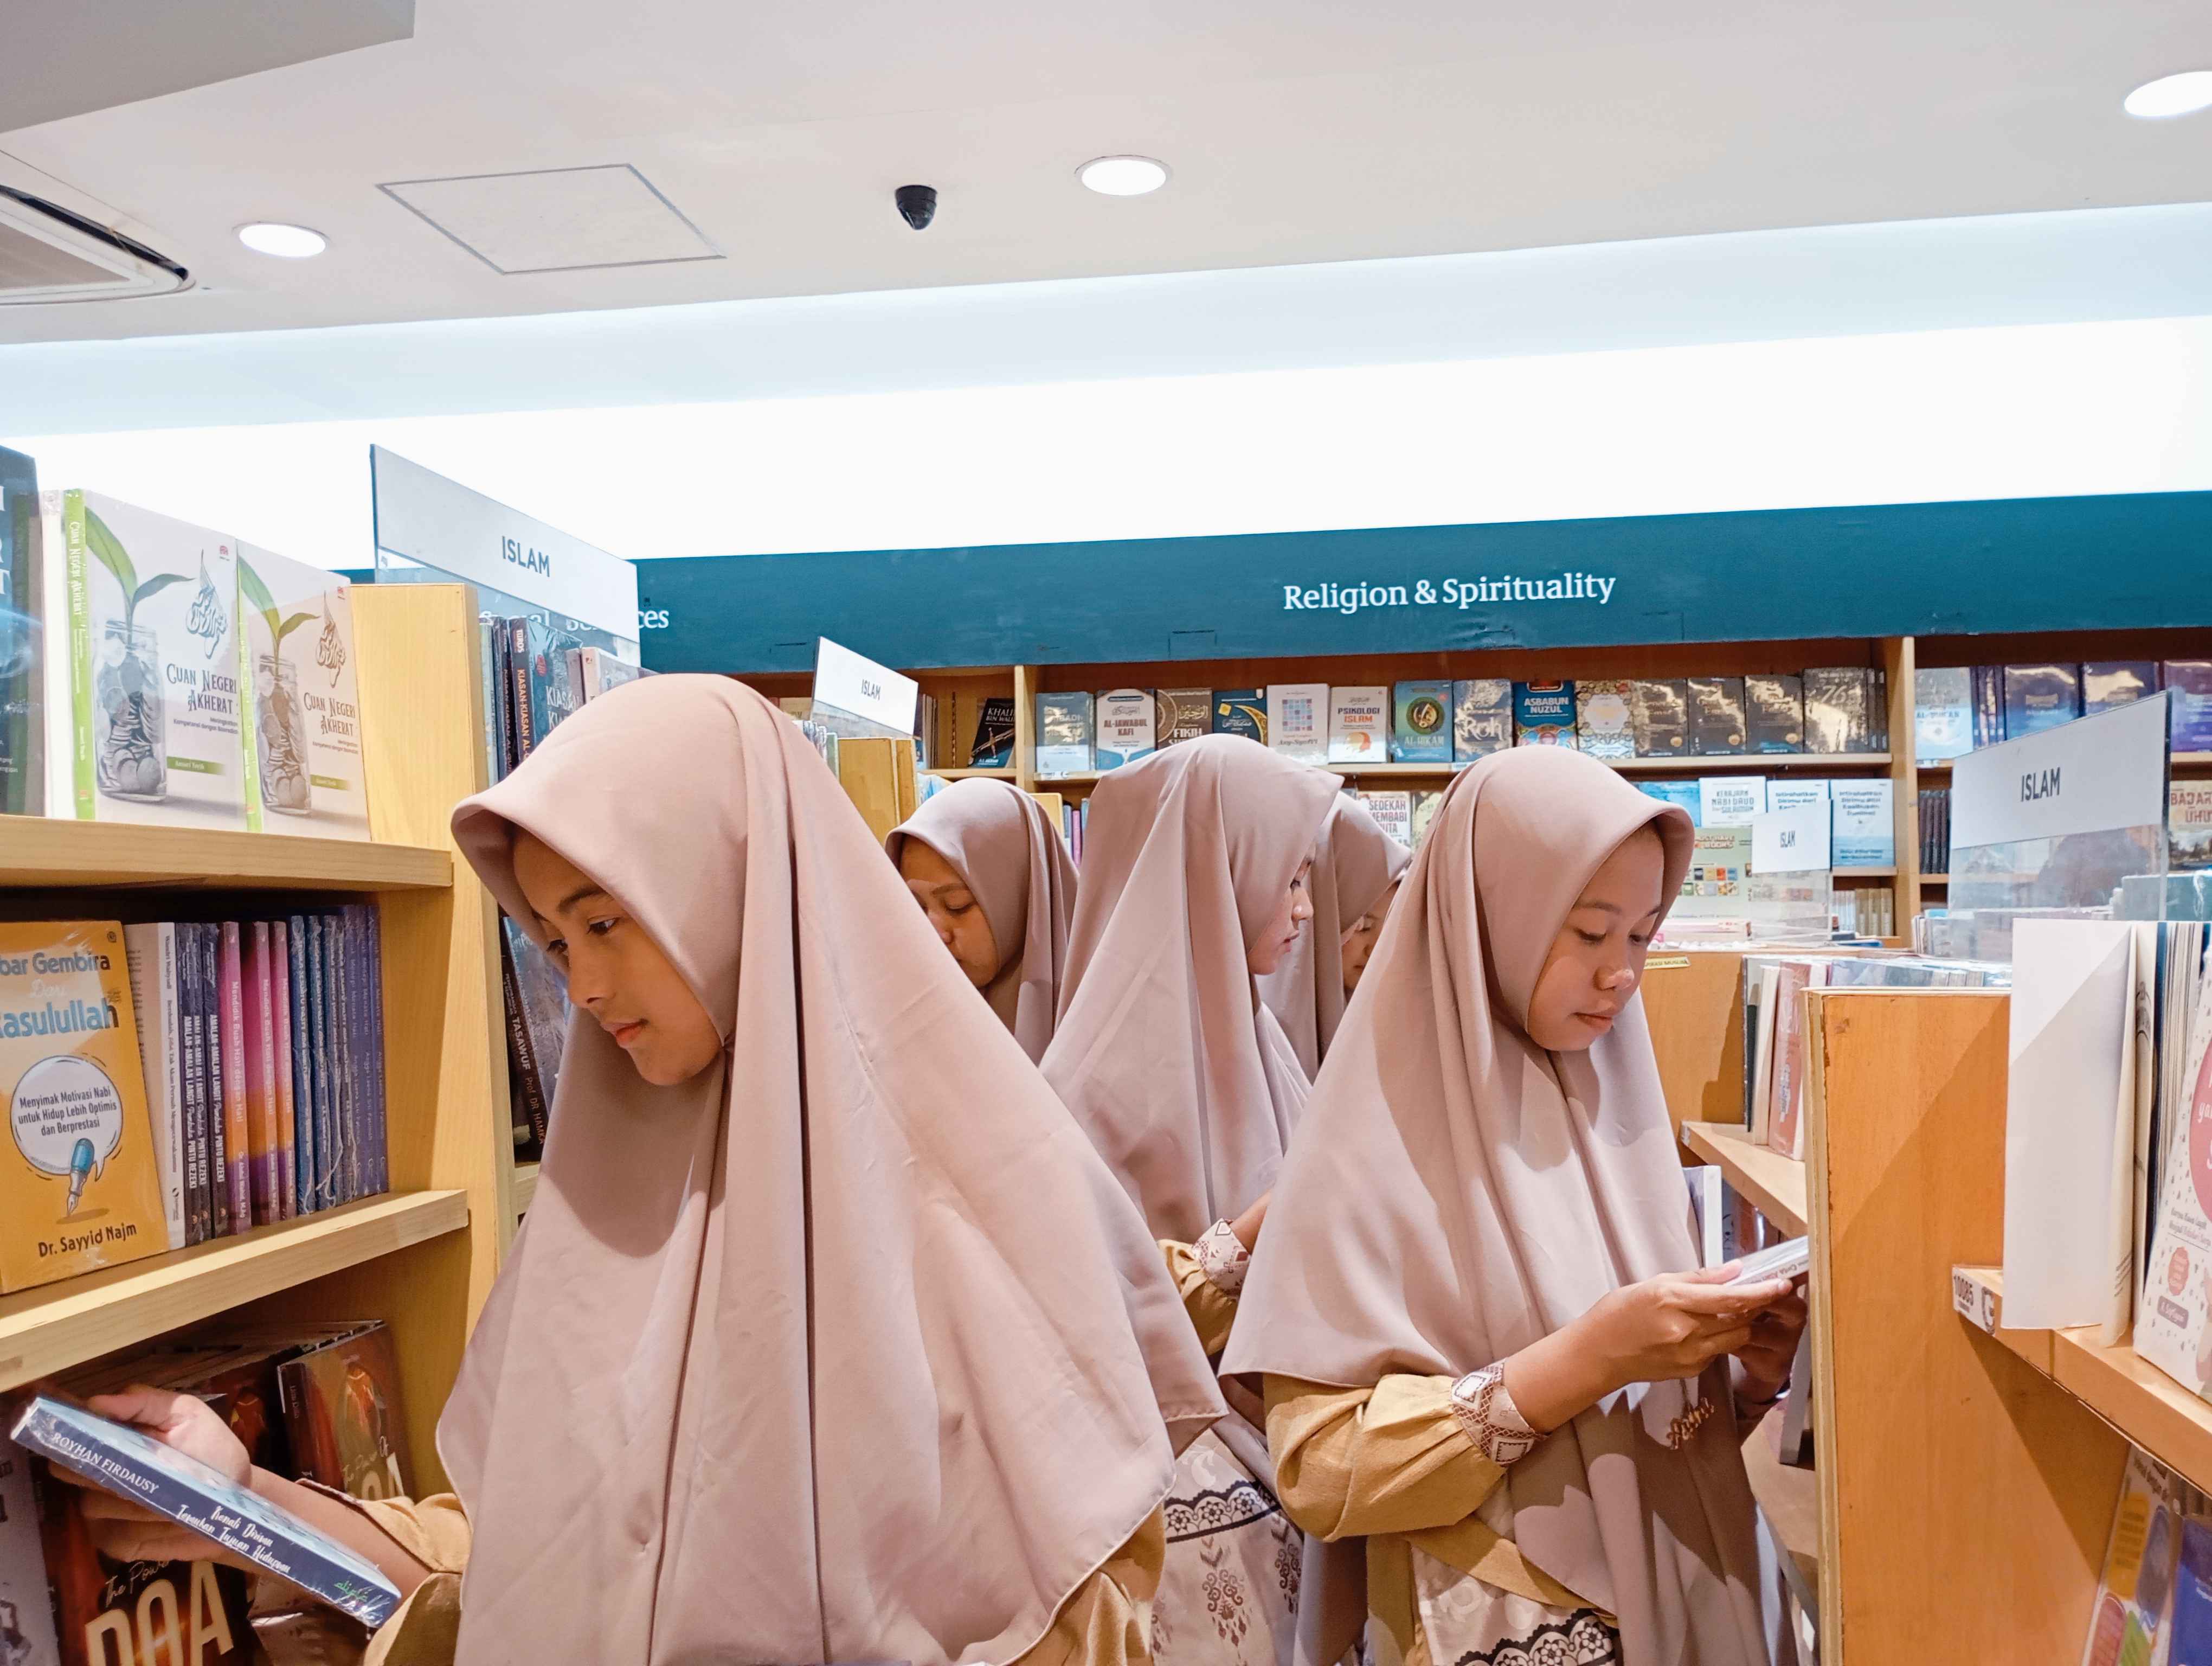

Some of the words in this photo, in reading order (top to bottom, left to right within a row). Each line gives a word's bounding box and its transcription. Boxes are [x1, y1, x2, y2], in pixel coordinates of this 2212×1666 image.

[501, 536, 550, 578] ISLAM
[1283, 581, 1409, 614] Religion
[1414, 579, 1438, 604] &
[1443, 572, 1616, 609] Spirituality
[167, 663, 197, 685] CUAN
[202, 670, 237, 694] NEGERI
[861, 678, 881, 701] ISLAM
[188, 690, 233, 714] AKHERAT
[304, 693, 326, 712] CUAN
[329, 697, 356, 719] NEGERI
[517, 669, 530, 736] KIASAN-KIASAN
[987, 707, 1014, 717] KHALI
[1524, 697, 1569, 707] ASBABUN
[1530, 706, 1563, 714] NUZUL
[321, 715, 353, 736] AKHERAT
[1103, 719, 1148, 728] AL-JAWABUL
[1117, 728, 1134, 736] KAFI
[2021, 767, 2061, 802] ISLAM
[1368, 800, 1406, 811] SEDEKAH
[1780, 830, 1795, 848] ISLAM
[32, 950, 111, 975] Gembira
[231, 981, 239, 1021] Mendidik
[0, 998, 119, 1039] asulullah
[184, 1016, 194, 1078] AMALAN-AMALAN
[210, 1014, 220, 1075] AMALAN-AMALAN
[511, 1016, 531, 1071] TASAWUF
[187, 1080, 195, 1105] LANGIT
[212, 1077, 222, 1101] LANGIT
[234, 1068, 242, 1101] dengan
[524, 1076, 536, 1094] Prof
[20, 1092, 59, 1112] Menyimak
[61, 1088, 93, 1104] Motivasi
[94, 1085, 111, 1099] Nabi
[529, 1097, 540, 1111] DR
[18, 1111, 41, 1126] untuk
[42, 1107, 65, 1123] Hidup
[66, 1104, 87, 1118] Lebih
[88, 1100, 117, 1116] Optimis
[41, 1124, 56, 1137] dan
[57, 1116, 100, 1136] Berprestasi
[532, 1113, 546, 1145] HAMKA
[188, 1140, 197, 1162] PINTU
[198, 1137, 207, 1158] PINTU
[216, 1135, 224, 1156] PINTU
[189, 1163, 197, 1189] REZEKI
[199, 1159, 207, 1185] REZEKI
[216, 1157, 225, 1183] REZEKI
[38, 1240, 58, 1258] Dr.
[61, 1229, 104, 1254] Sayyid
[106, 1222, 137, 1246] Najm
[53, 1432, 102, 1465] ROYHAN
[101, 1457, 159, 1495] FIRDAUSY
[176, 1503, 215, 1534] Temukan
[216, 1527, 249, 1552] Tujuan
[253, 1545, 292, 1573] Hidupmu
[210, 1505, 242, 1530] Kenali
[242, 1522, 274, 1548] Dirimu
[105, 1574, 126, 1607] The
